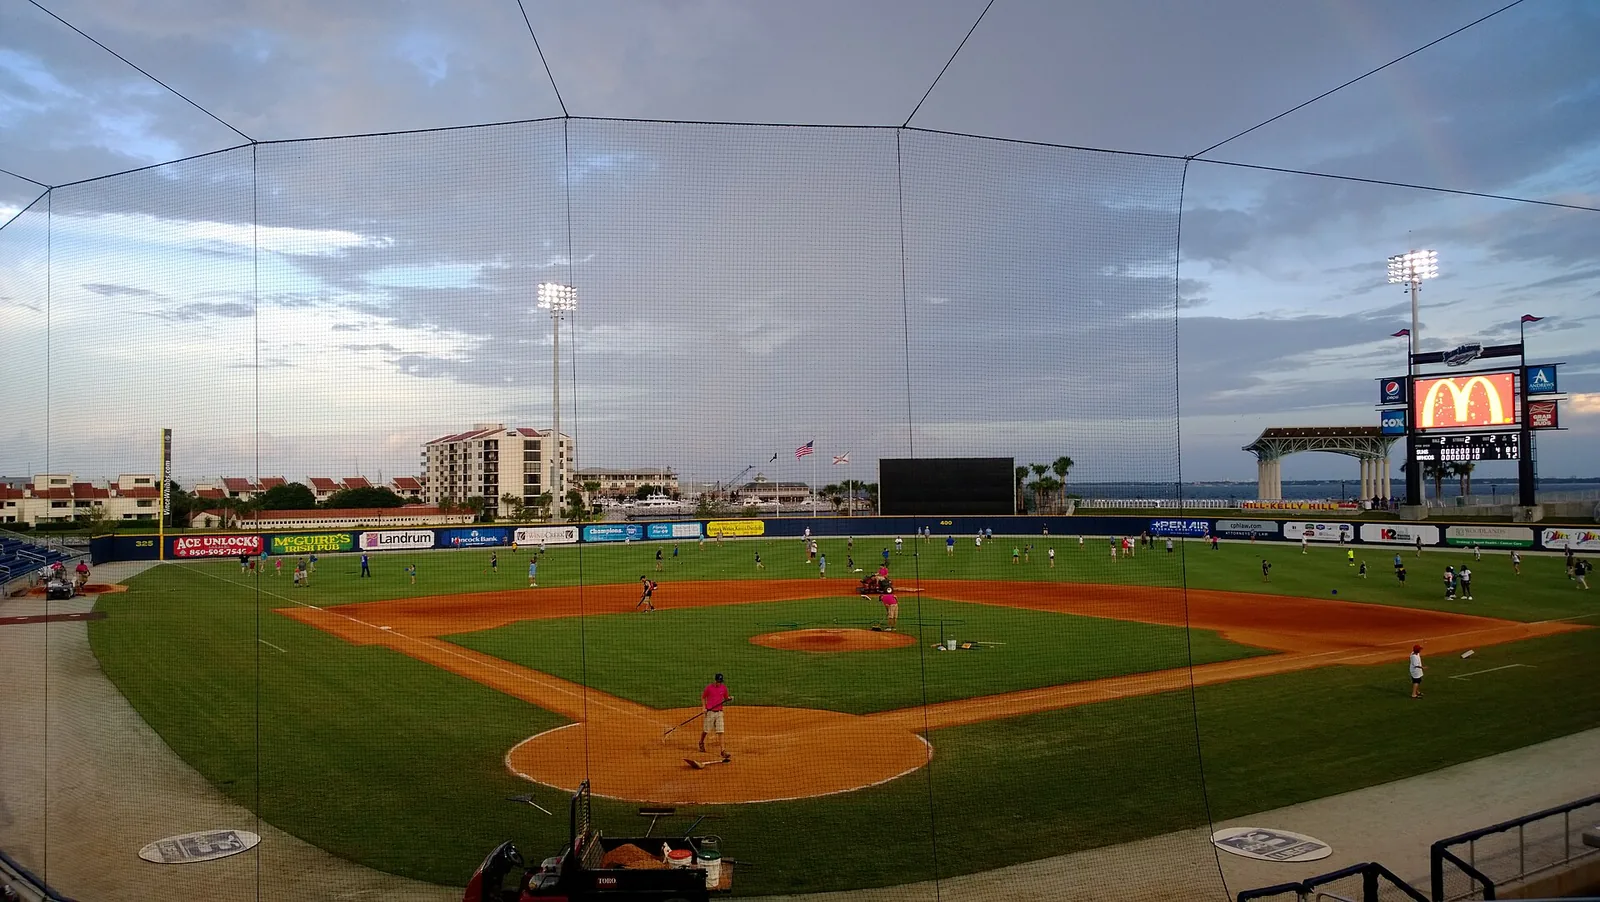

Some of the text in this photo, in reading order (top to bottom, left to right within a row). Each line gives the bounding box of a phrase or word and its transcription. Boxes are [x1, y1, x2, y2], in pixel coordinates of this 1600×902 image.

[1382, 418, 1404, 428] COX
[380, 533, 430, 544] Landrum
[1381, 529, 1396, 540] K2
[177, 536, 259, 550] ACE UNLOCKS
